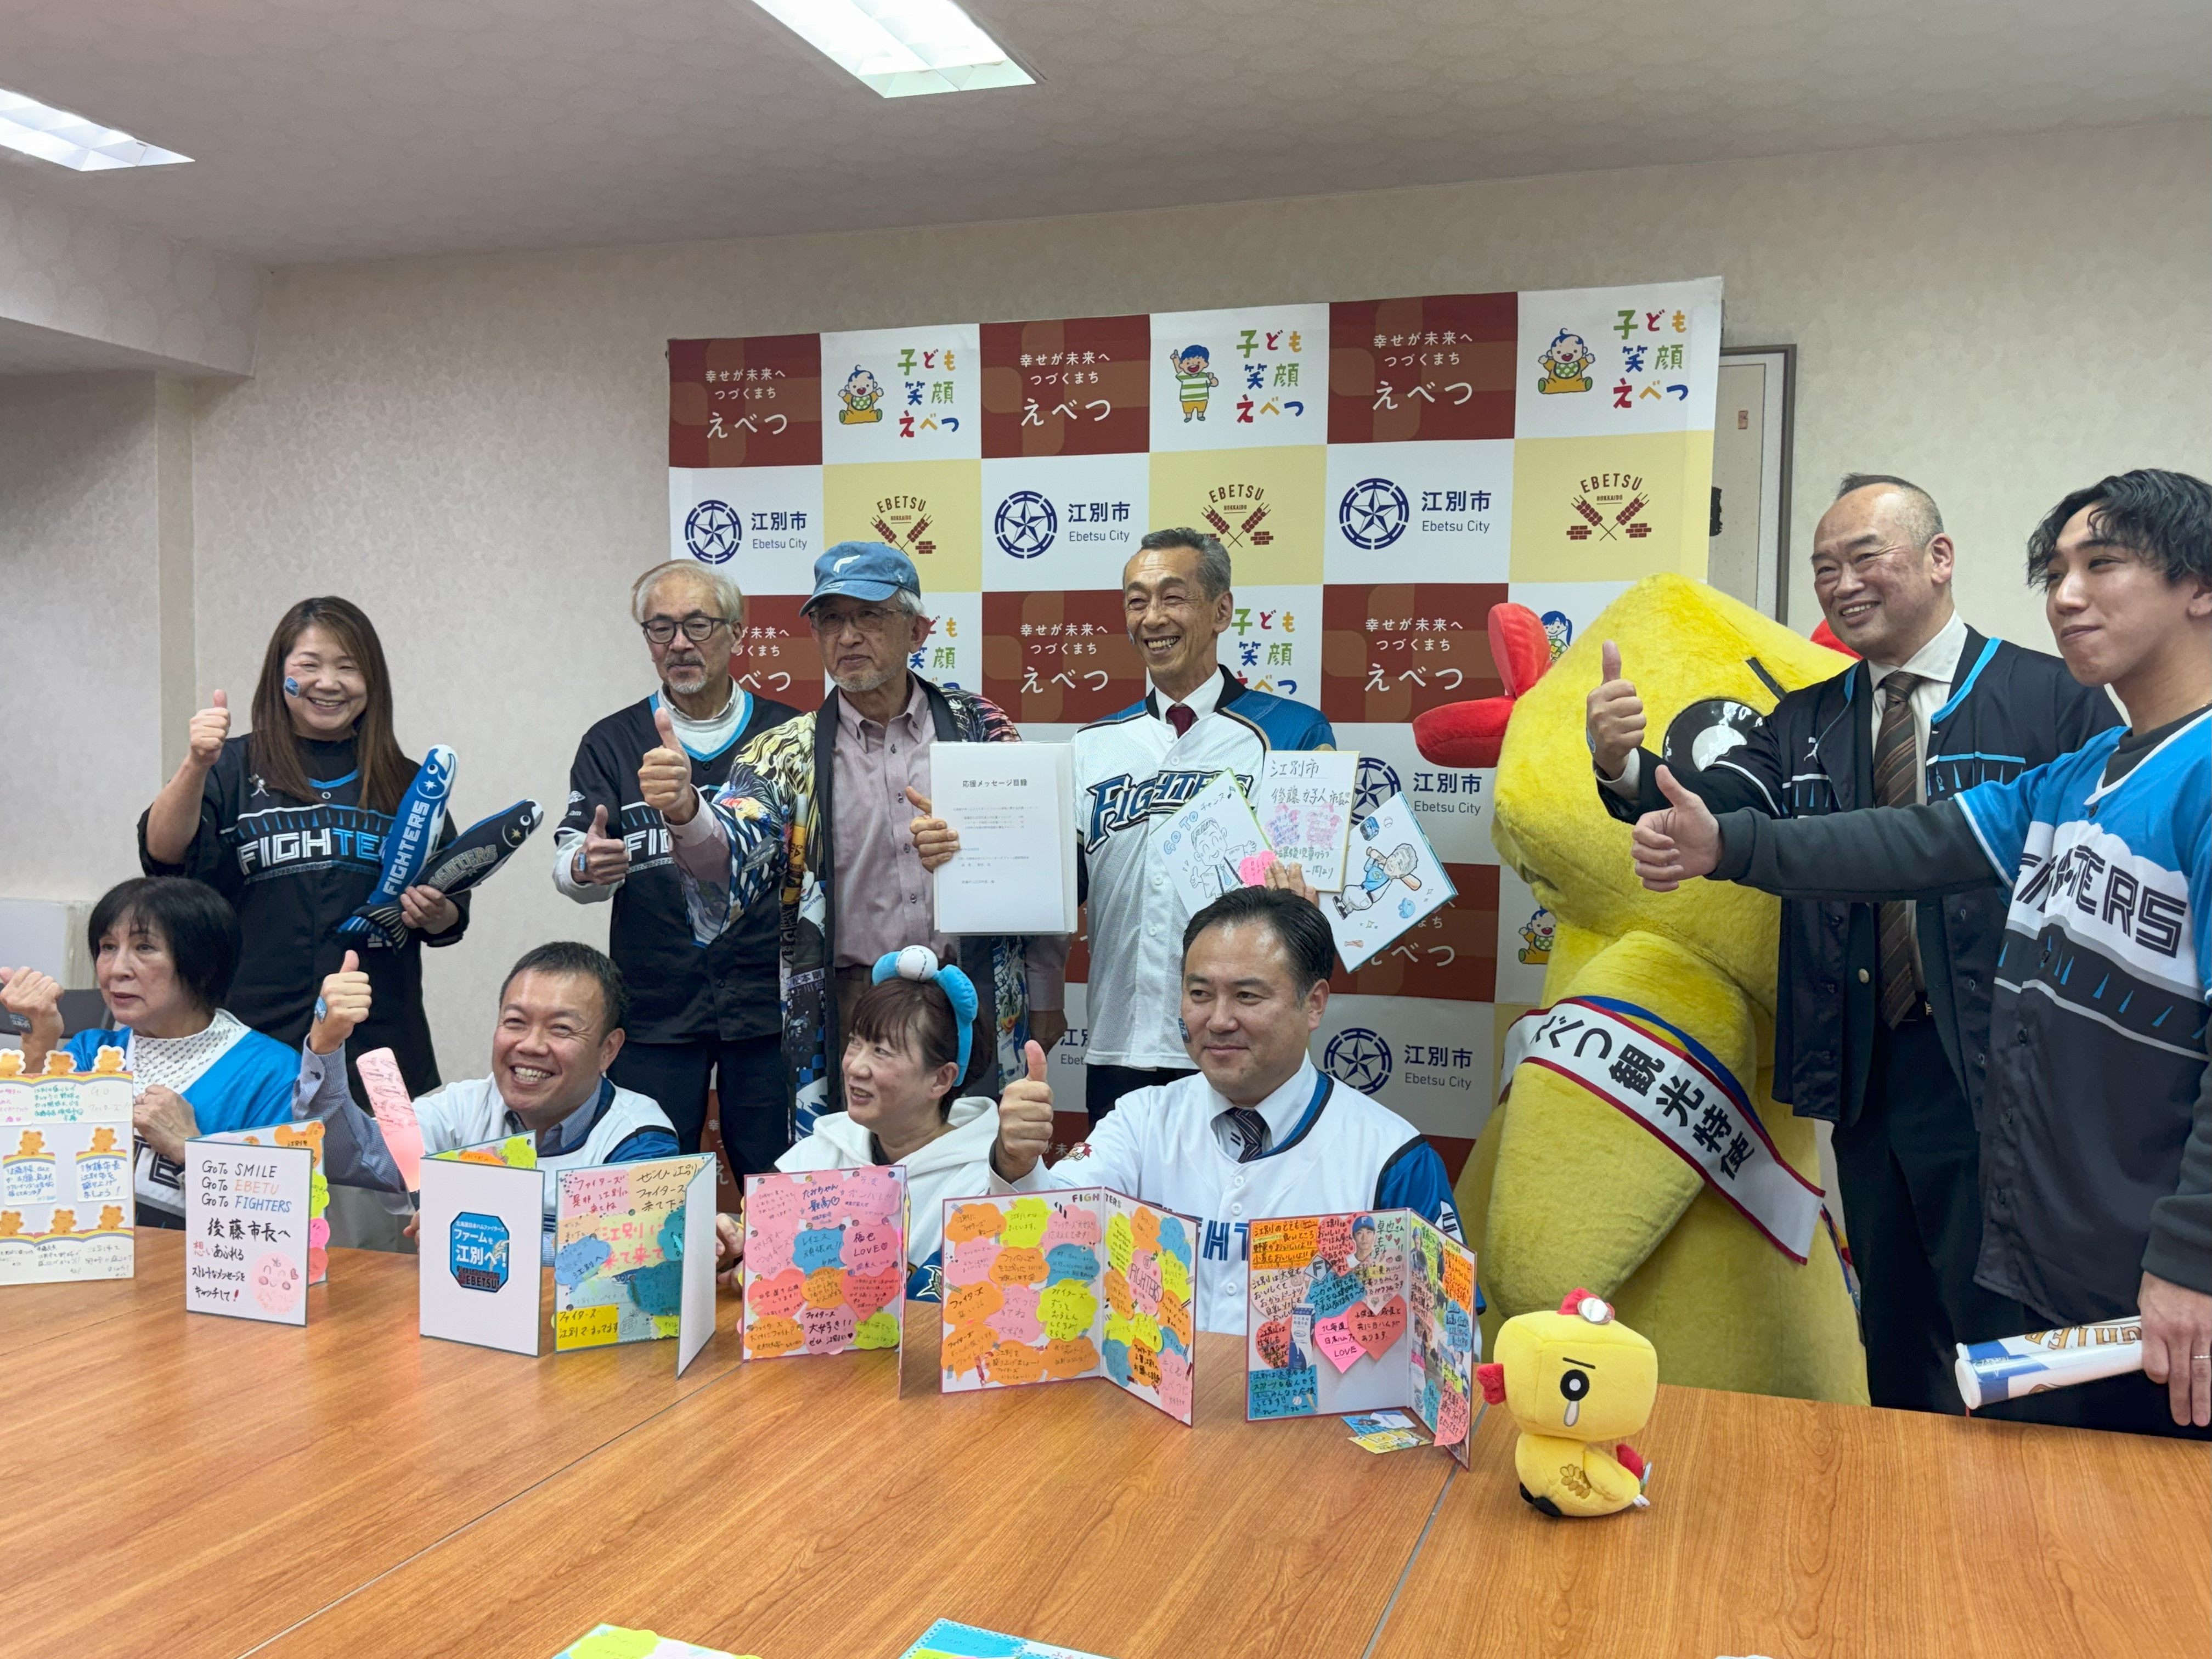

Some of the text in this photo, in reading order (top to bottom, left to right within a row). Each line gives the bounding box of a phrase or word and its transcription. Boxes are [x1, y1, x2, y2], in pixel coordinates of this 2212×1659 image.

[1613, 309, 1686, 340] 子ども
[1237, 330, 1302, 358] 子ども
[1373, 331, 1472, 349] 幸せが未来へ
[898, 348, 956, 375] 子ども
[1020, 352, 1110, 368] 幸せが未来へ
[1384, 352, 1460, 366] つづくまち
[1625, 343, 1683, 373] 笑顔
[706, 368, 786, 383] 幸せが未来へ
[1031, 371, 1099, 386] つづくまち
[1246, 362, 1299, 389] 笑顔
[715, 386, 776, 399] つづくまち
[905, 381, 955, 405] 笑顔
[1373, 379, 1472, 410] えべつ
[1613, 378, 1689, 409] えべつ
[1021, 398, 1111, 426] えべつ
[1236, 396, 1304, 424] えべつ
[707, 412, 787, 438] えべつ
[898, 410, 960, 438] えべつ
[1580, 473, 1643, 493] EBETSU
[1209, 484, 1264, 503] EBETSU
[1421, 489, 1492, 514] 江別市
[877, 496, 926, 514] EBETSU
[1068, 502, 1130, 522] 江別市
[751, 511, 807, 531] 江別市
[1421, 518, 1490, 534] Ebetsu City
[752, 537, 808, 551] Ebetsu City
[1069, 530, 1130, 543] Ebetsu City
[1020, 623, 1108, 637] 幸せが未来へ
[1232, 609, 1295, 636] 子ども
[1365, 618, 1463, 633] 幸せが未来へ
[1030, 642, 1097, 655] つづくまち
[1376, 637, 1451, 651] つづくまち
[1238, 642, 1293, 667] 笑顔
[1020, 667, 1109, 694] えべつ
[1364, 663, 1463, 692] えべつ
[1270, 759, 1319, 778] 江別市
[962, 779, 1028, 788] 応援メッセージ目録
[1413, 772, 1481, 794] 江別市
[1414, 800, 1481, 817] Ebetsu City
[236, 827, 386, 875] FIGHTE
[383, 800, 430, 895] FIGHTERS
[1404, 1044, 1472, 1069] 江別市
[1405, 1072, 1472, 1090] Ebetsu City
[235, 1164, 277, 1178] SMILE
[234, 1180, 279, 1195] EBETU
[235, 1195, 292, 1213] FIGHTERS
[207, 1218, 291, 1243] 後藤市長へ
[454, 1228, 493, 1245] ファームを
[854, 1245, 881, 1257] LOVE
[1313, 1260, 1323, 1277] F
[950, 1287, 984, 1309] ファイターズ
[1334, 1346, 1357, 1357] LOVE
